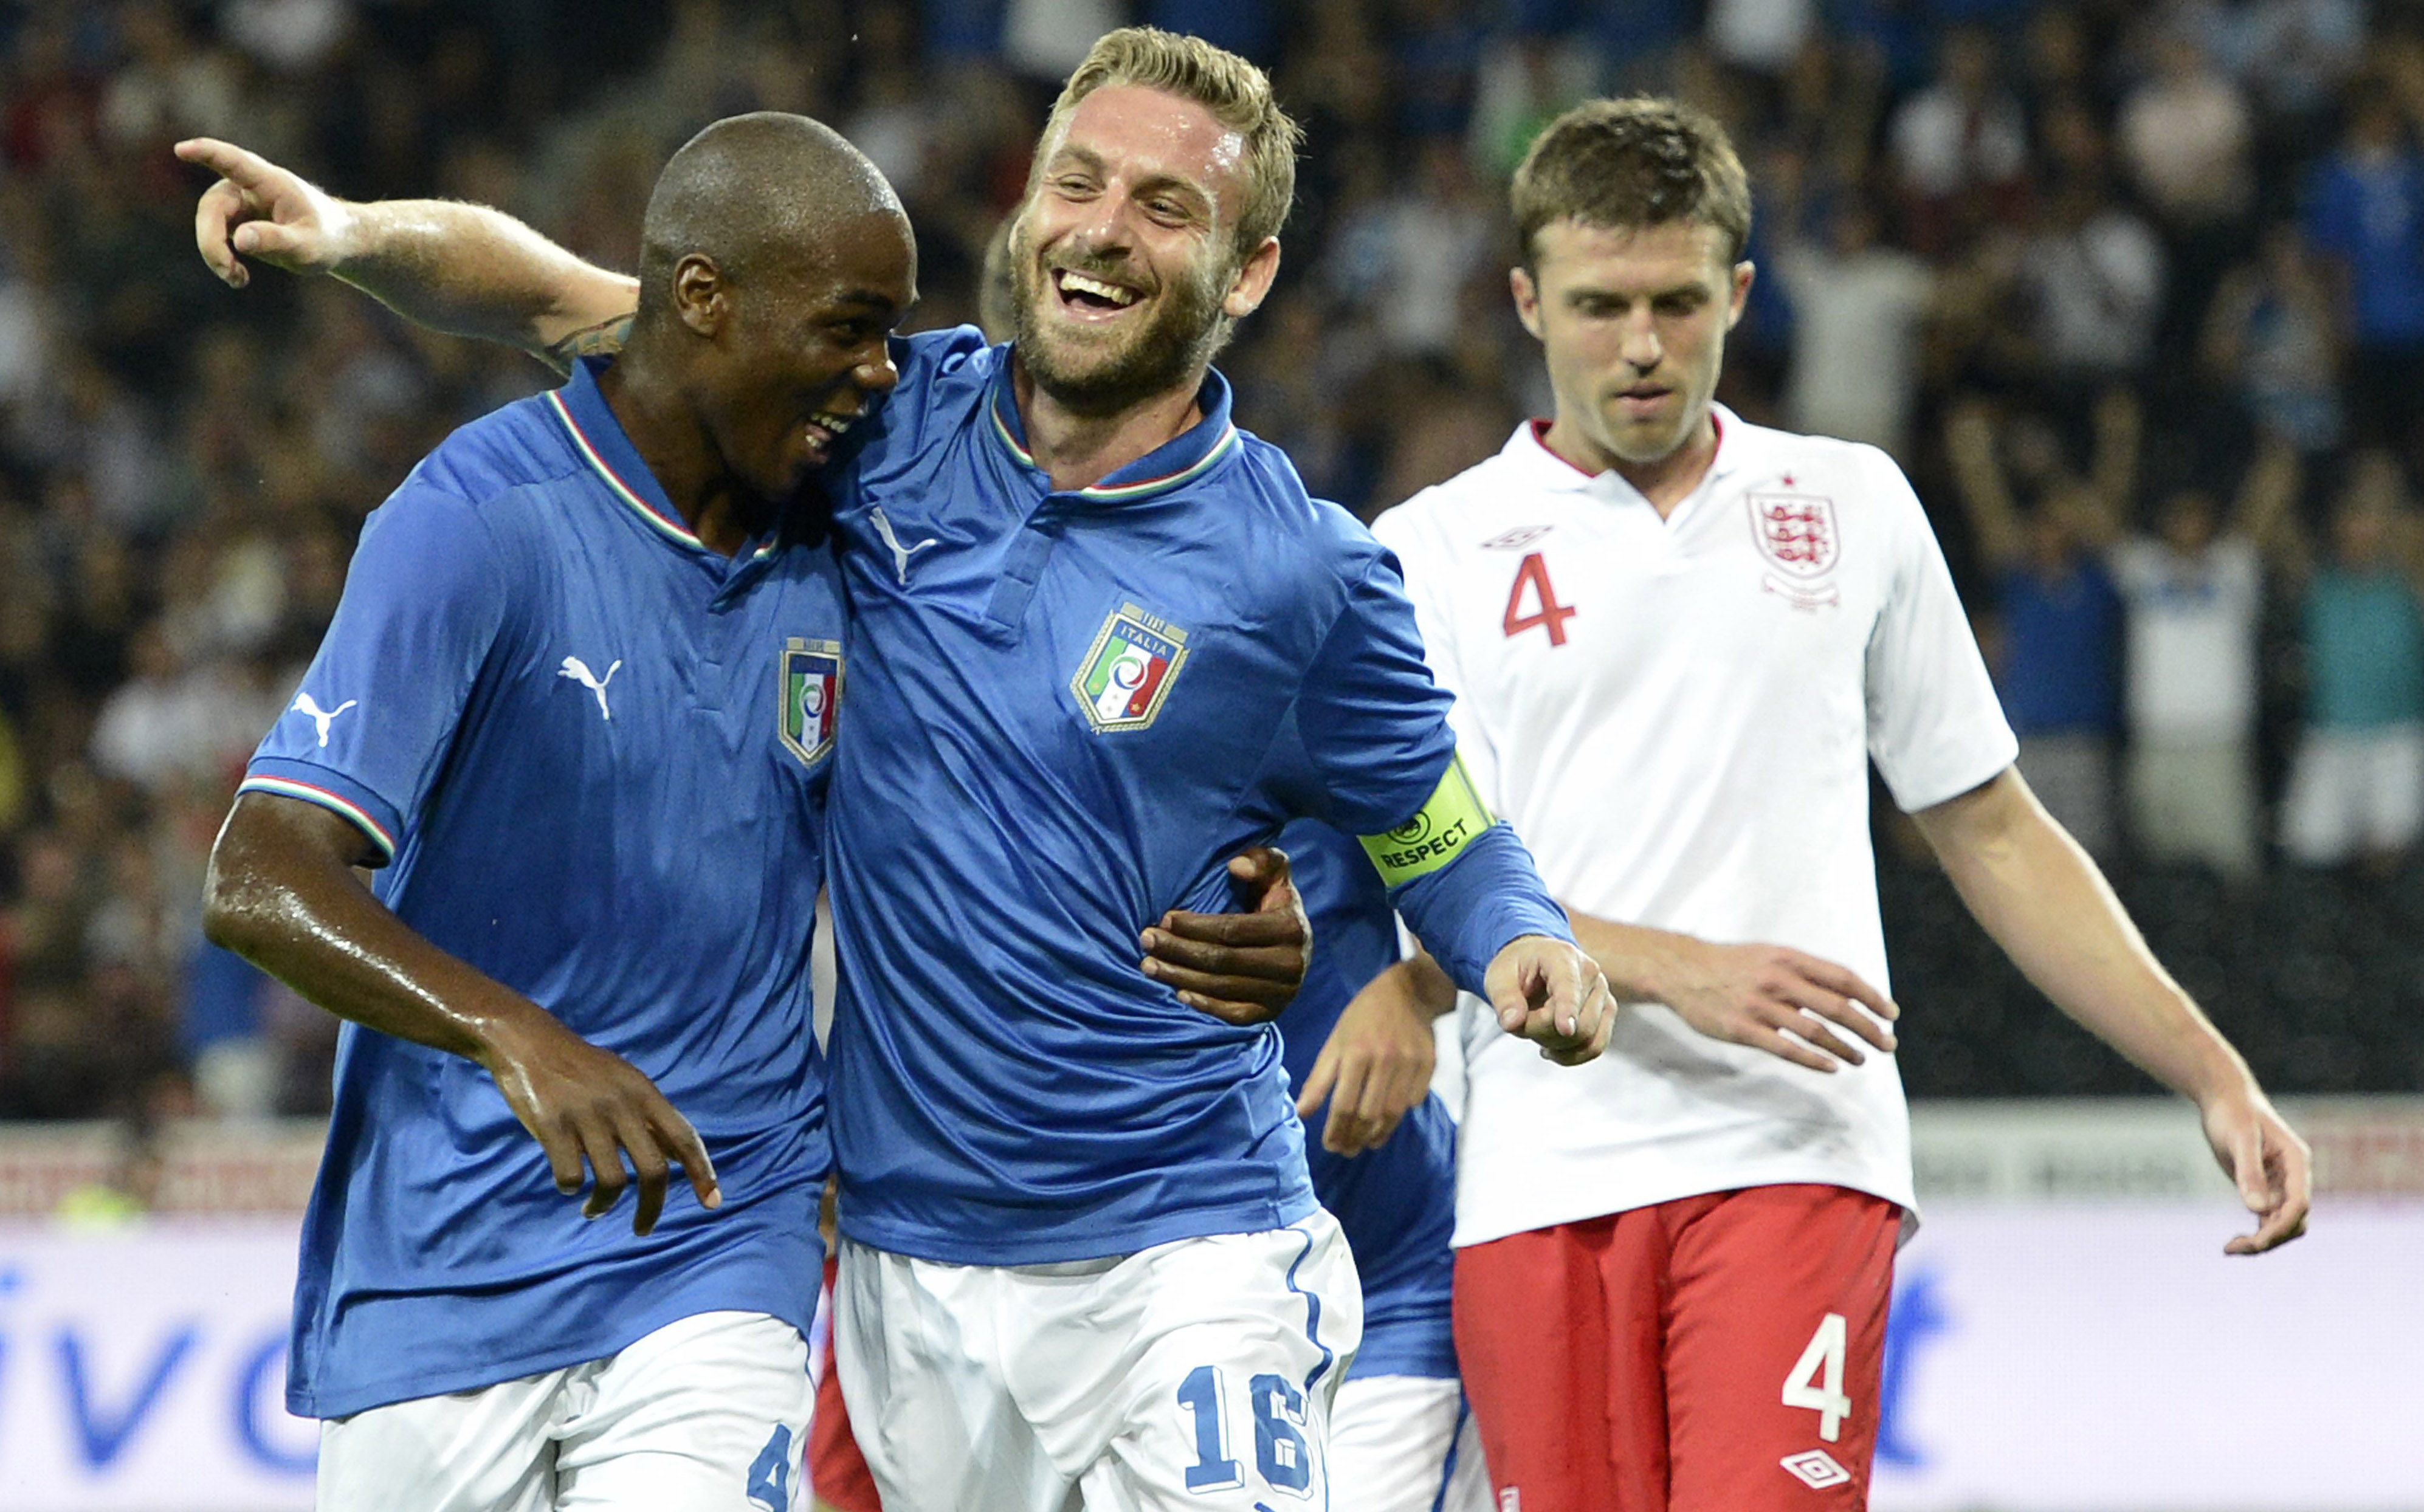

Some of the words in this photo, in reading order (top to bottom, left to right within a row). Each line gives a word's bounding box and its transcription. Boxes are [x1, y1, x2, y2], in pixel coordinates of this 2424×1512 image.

[1120, 625, 1168, 656] ITALIA
[1504, 552, 1576, 647] 4
[1380, 818, 1467, 868] RESPECT
[1781, 1311, 1852, 1443] 4
[1177, 1364, 1314, 1501] 16
